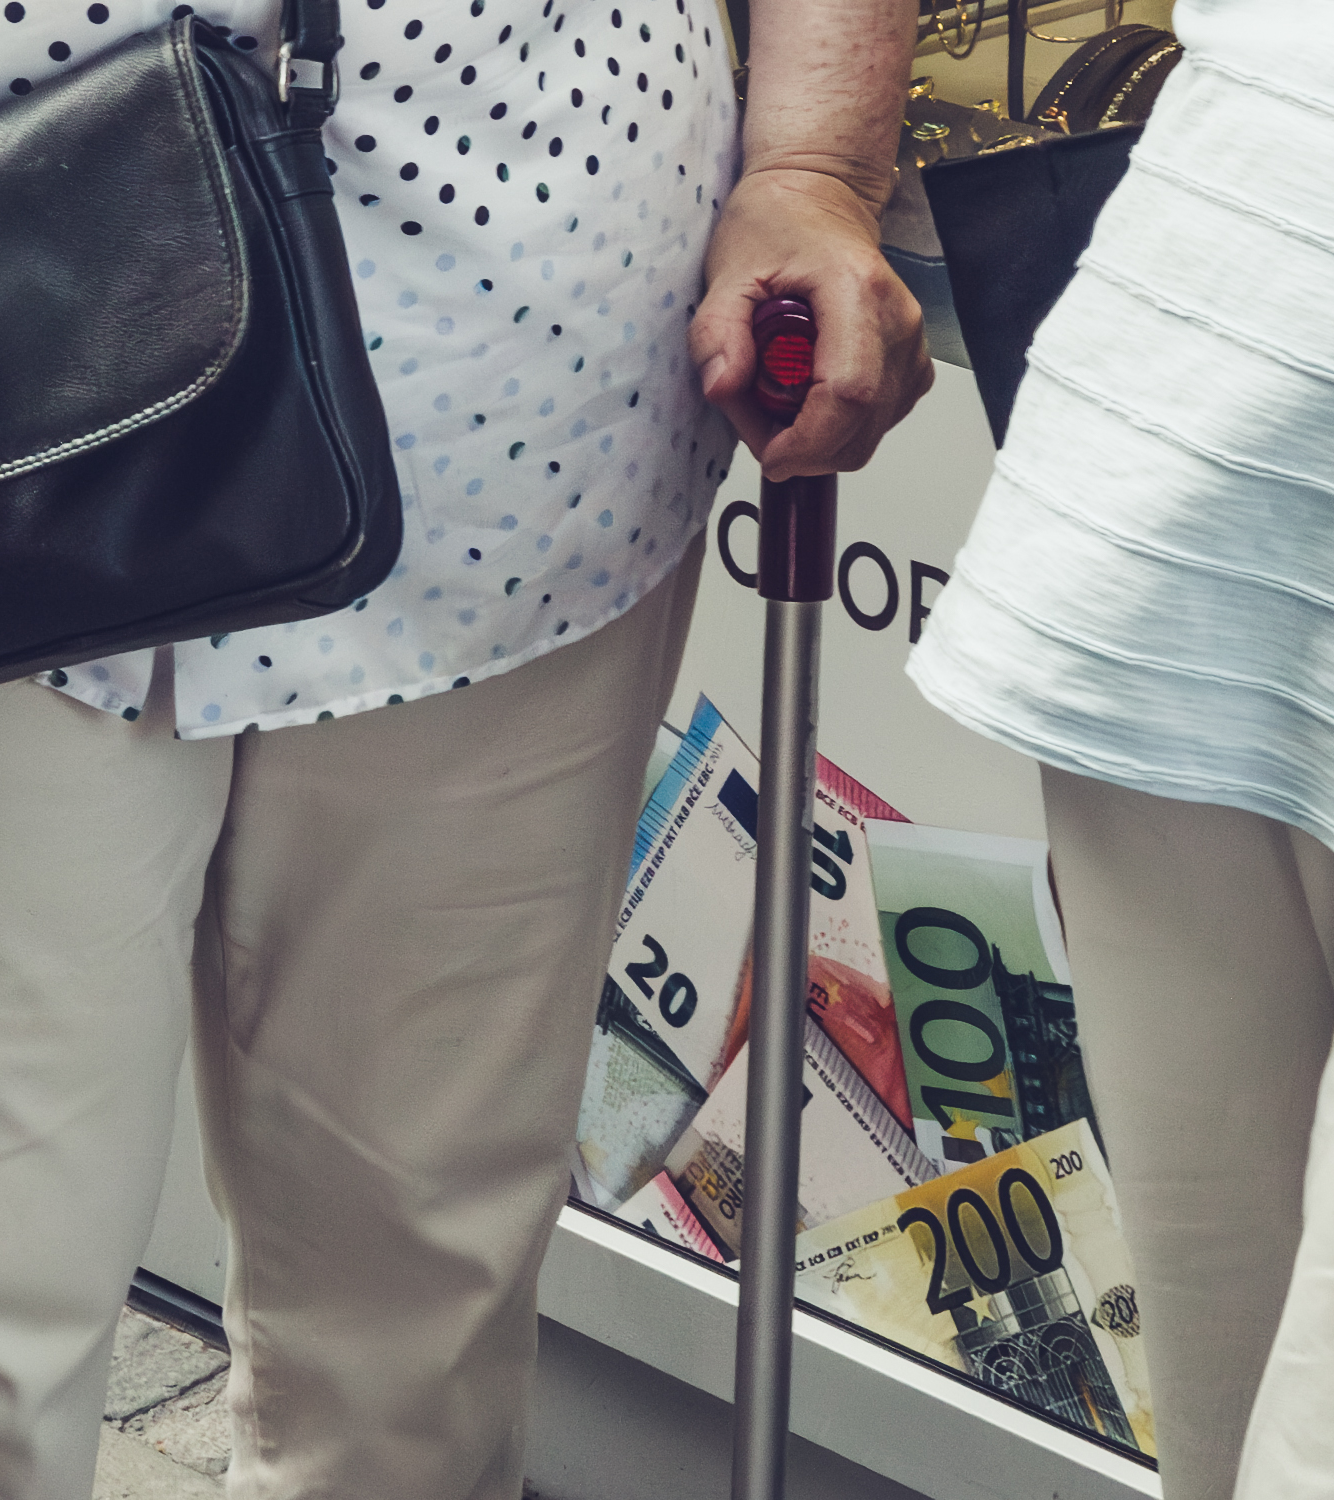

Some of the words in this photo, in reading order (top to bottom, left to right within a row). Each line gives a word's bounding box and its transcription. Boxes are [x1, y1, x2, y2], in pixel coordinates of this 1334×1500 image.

[810, 823, 854, 901] 10
[624, 933, 698, 1029] 20
[894, 906, 1015, 1132] 100
[1048, 1149, 1084, 1181] 200
[896, 1167, 1065, 1316] 200
